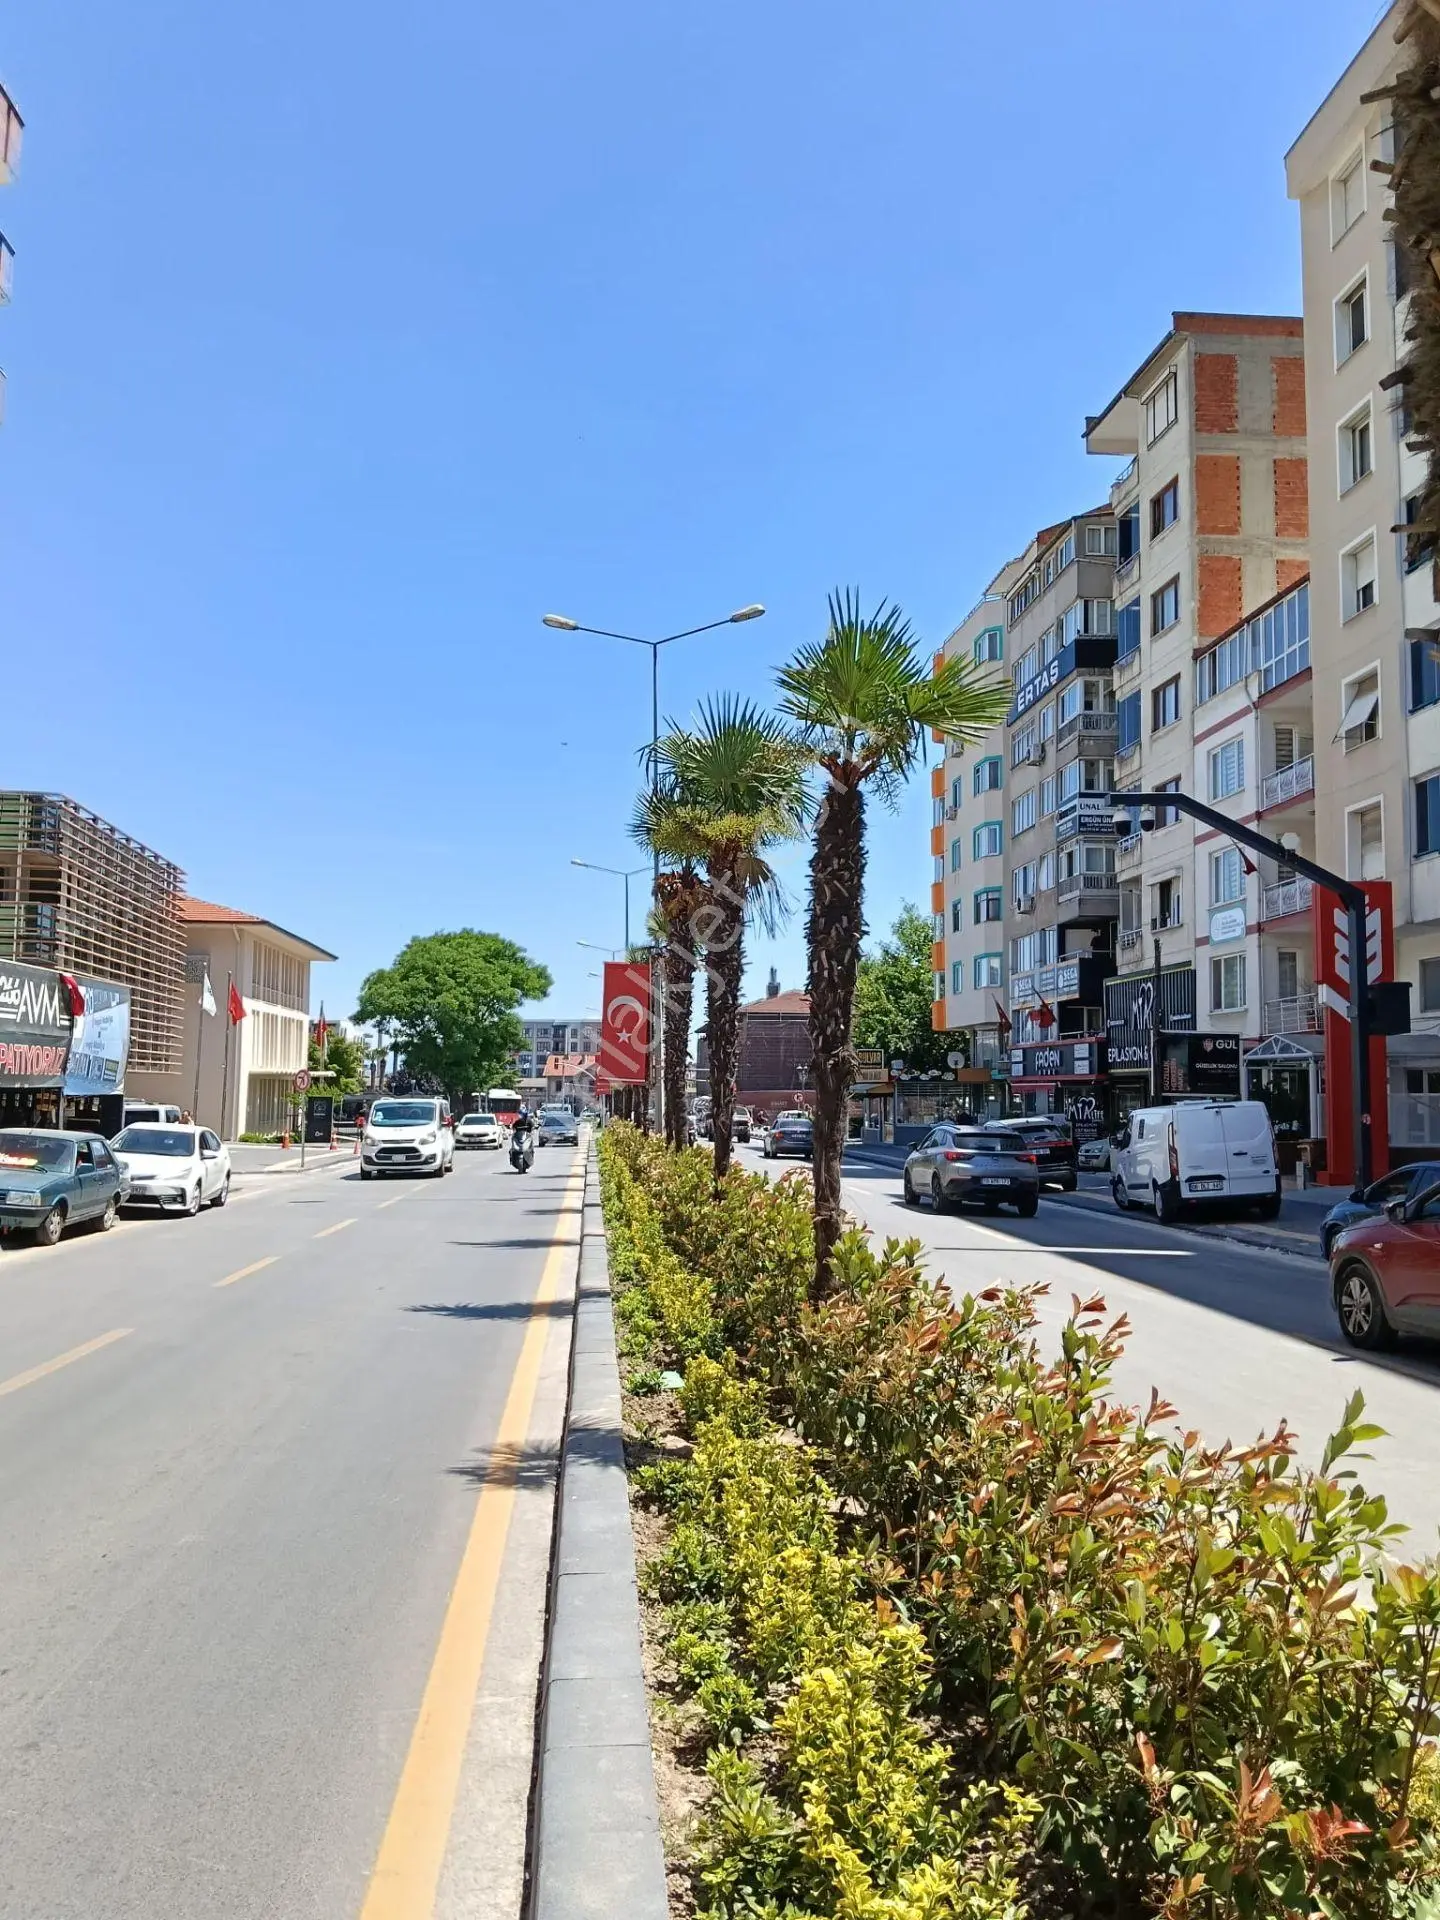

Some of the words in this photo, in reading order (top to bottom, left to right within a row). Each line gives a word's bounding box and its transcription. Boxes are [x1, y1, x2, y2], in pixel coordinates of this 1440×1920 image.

[1017, 660, 1059, 713] ERTAŞ
[16, 978, 60, 1027] AVM
[1215, 1039, 1238, 1050] GÜL
